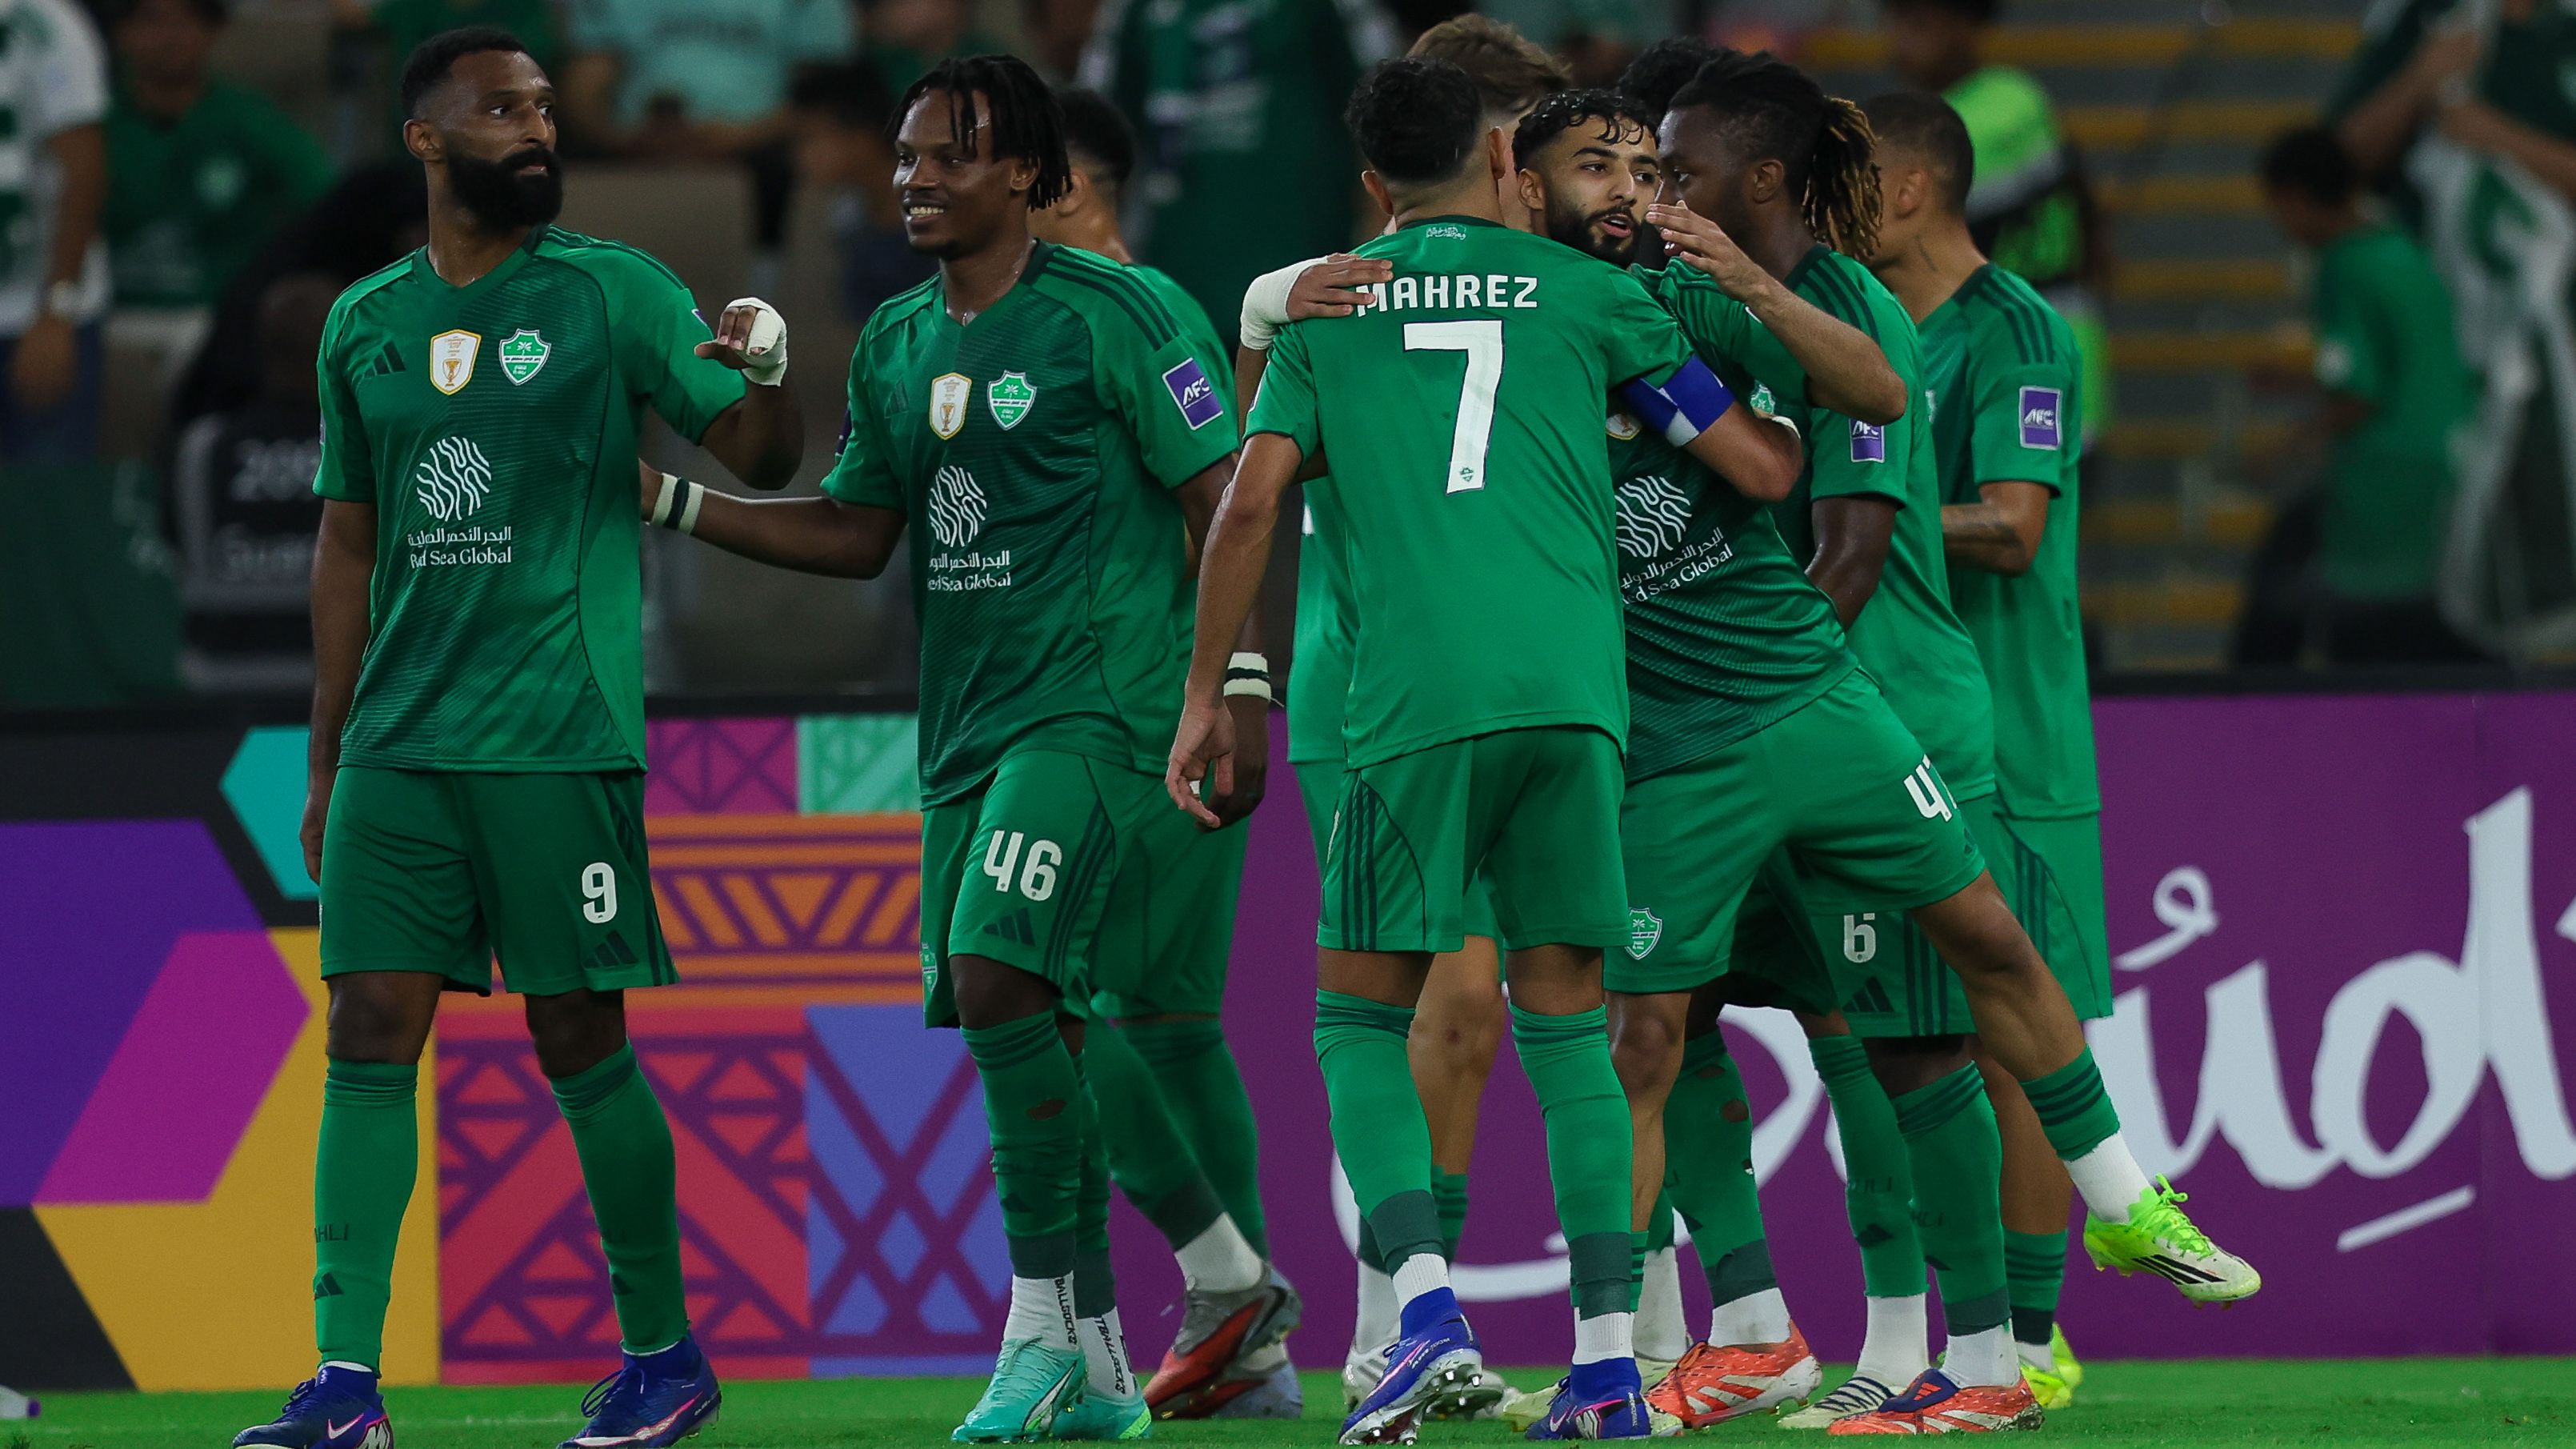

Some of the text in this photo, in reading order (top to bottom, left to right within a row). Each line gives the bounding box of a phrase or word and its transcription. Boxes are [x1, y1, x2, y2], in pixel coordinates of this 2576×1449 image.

[1355, 274, 1538, 317] MAHREZ
[1182, 377, 1210, 406] AFC
[1403, 319, 1504, 494] 7
[2024, 408, 2055, 426] AFC
[445, 526, 481, 546] الأحمر
[482, 526, 512, 546] البحر
[1696, 526, 1725, 558] البحر
[410, 546, 512, 569] Rd Sea Global
[949, 552, 981, 573] الأحمر
[981, 550, 1010, 571] البحر
[1658, 543, 1698, 577] الأحمر
[928, 575, 942, 590] ed
[964, 572, 1011, 590] Global
[1622, 542, 1734, 605] ed Sea Global
[982, 829, 1063, 902] 46
[582, 862, 618, 924] 9
[1843, 912, 1877, 963] 6
